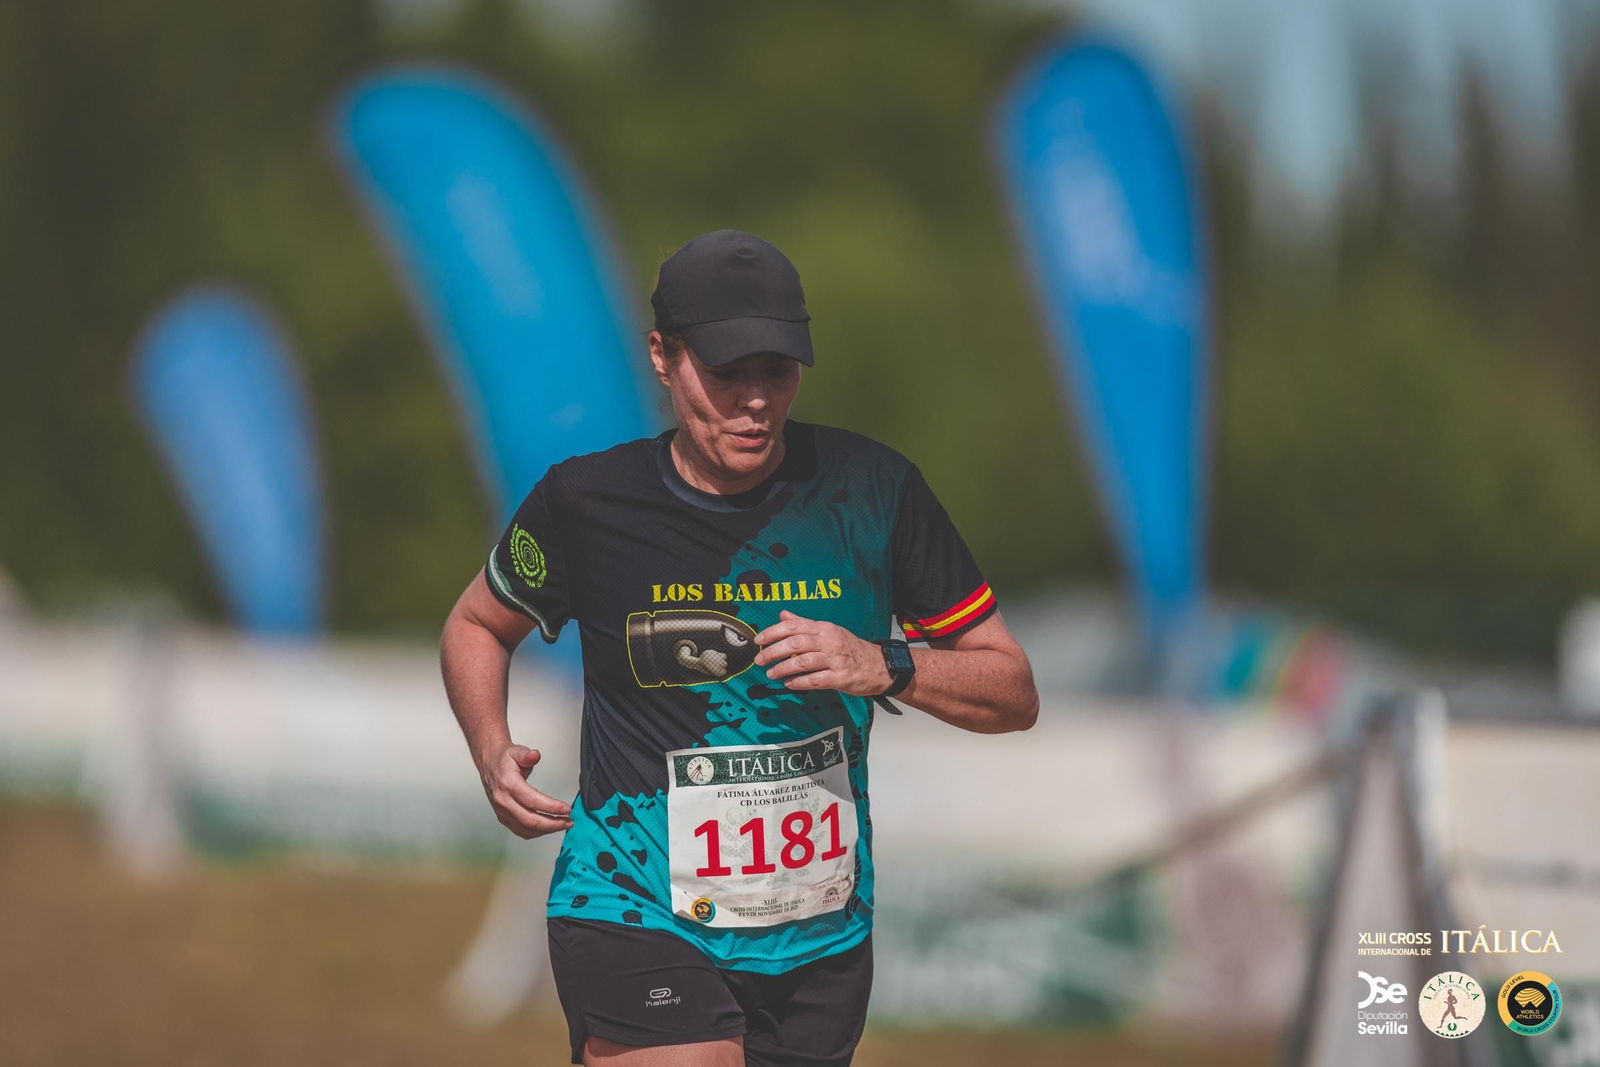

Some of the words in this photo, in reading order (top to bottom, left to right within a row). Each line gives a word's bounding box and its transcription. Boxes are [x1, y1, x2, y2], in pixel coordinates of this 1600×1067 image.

[652, 583, 704, 602] LOS
[714, 578, 842, 602] BALILLAS
[728, 751, 816, 777] ITÁLICA
[717, 788, 750, 799] FÁTIMA
[752, 786, 790, 798] ÁLVAREZ
[791, 779, 826, 793] BAUTISTA
[740, 799, 752, 807] CD
[754, 798, 771, 807] LOS
[772, 792, 809, 805] BALILLAS
[694, 802, 848, 878] 1181
[746, 903, 783, 912] INTERNACIONAL
